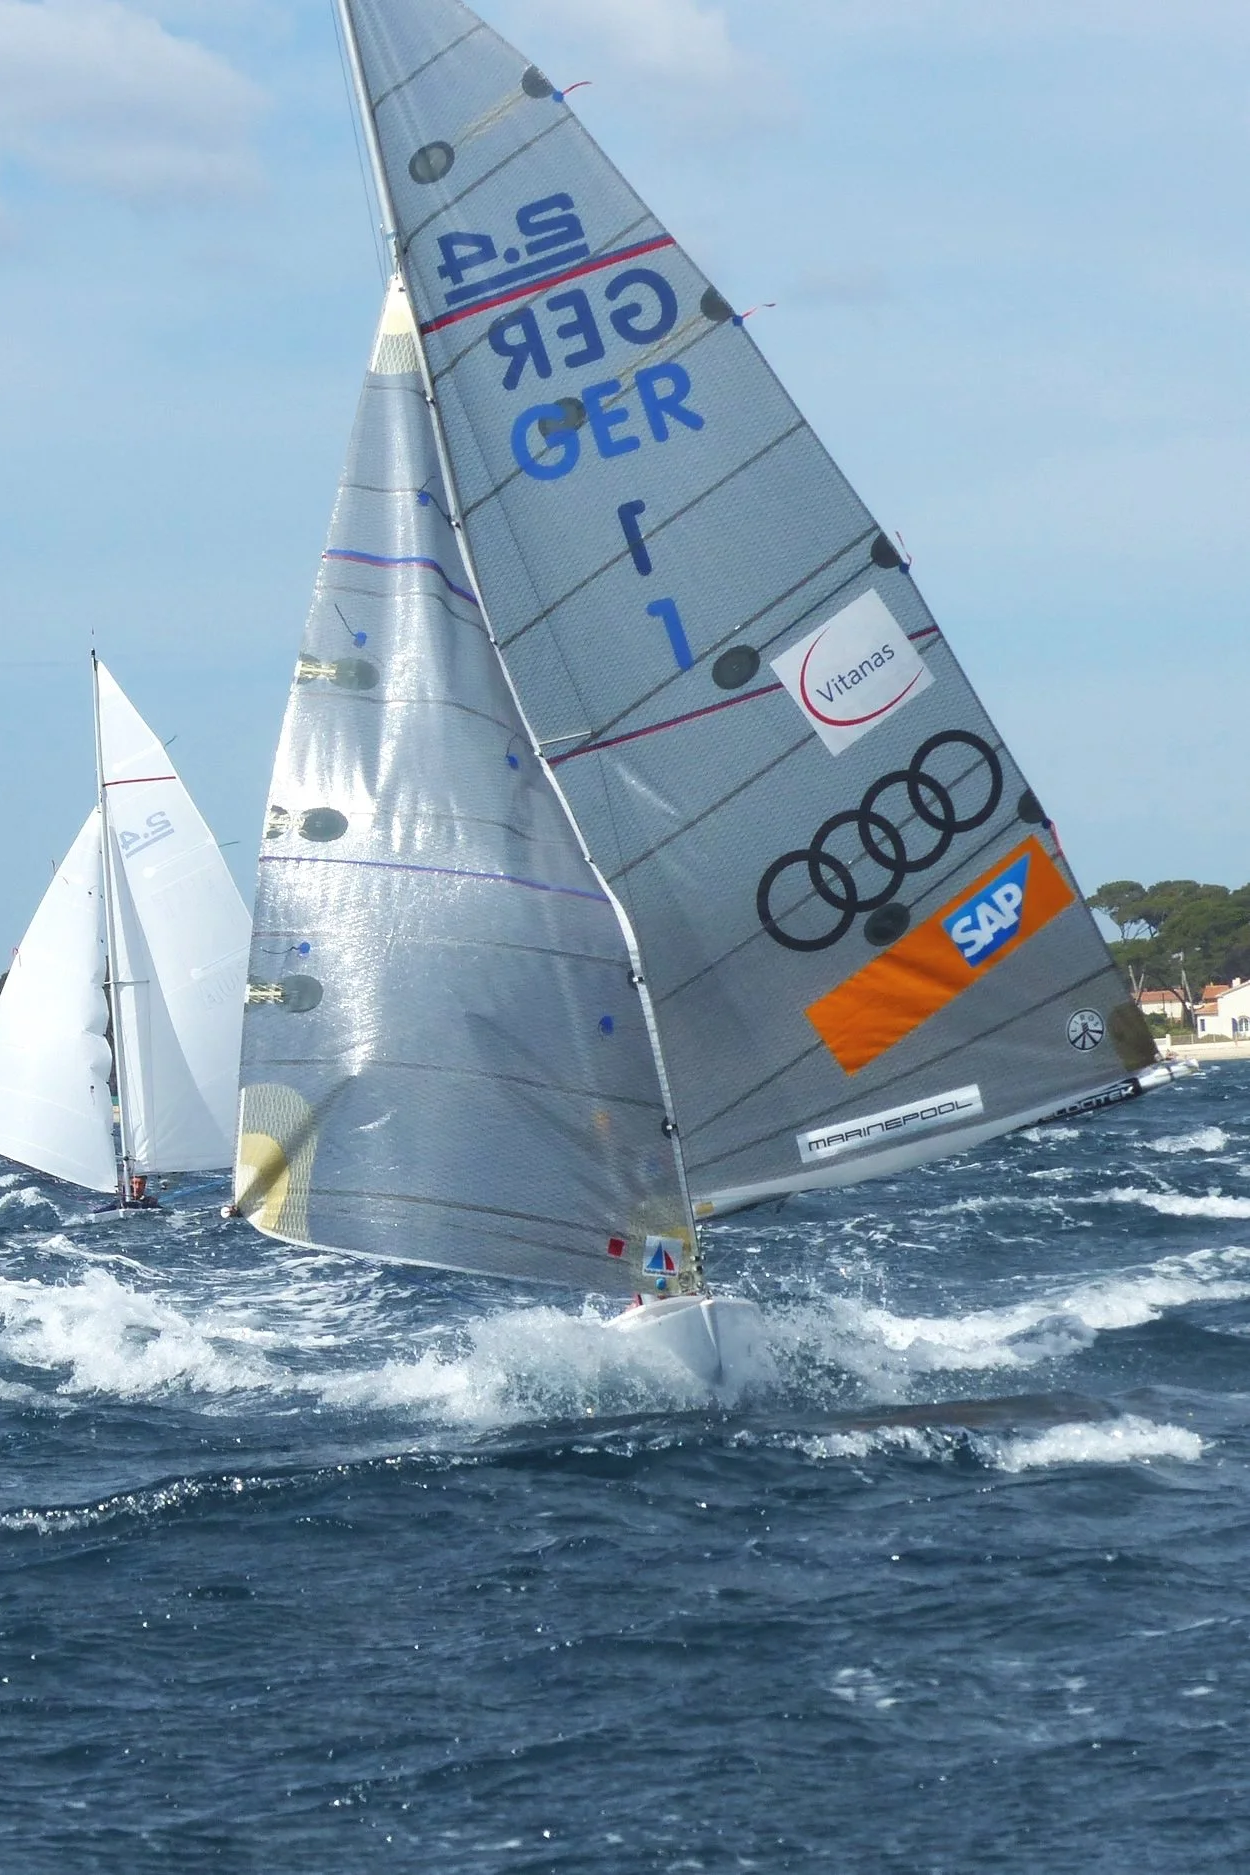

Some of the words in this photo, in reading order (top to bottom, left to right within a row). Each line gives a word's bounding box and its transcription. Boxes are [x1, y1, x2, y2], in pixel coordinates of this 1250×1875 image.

[511, 362, 704, 480] GER
[647, 598, 695, 671] 1
[816, 644, 895, 702] Vitanas
[950, 882, 1023, 959] SAP
[808, 1101, 973, 1151] MARINEPOOL
[1039, 1086, 1135, 1119] LOCITEK
